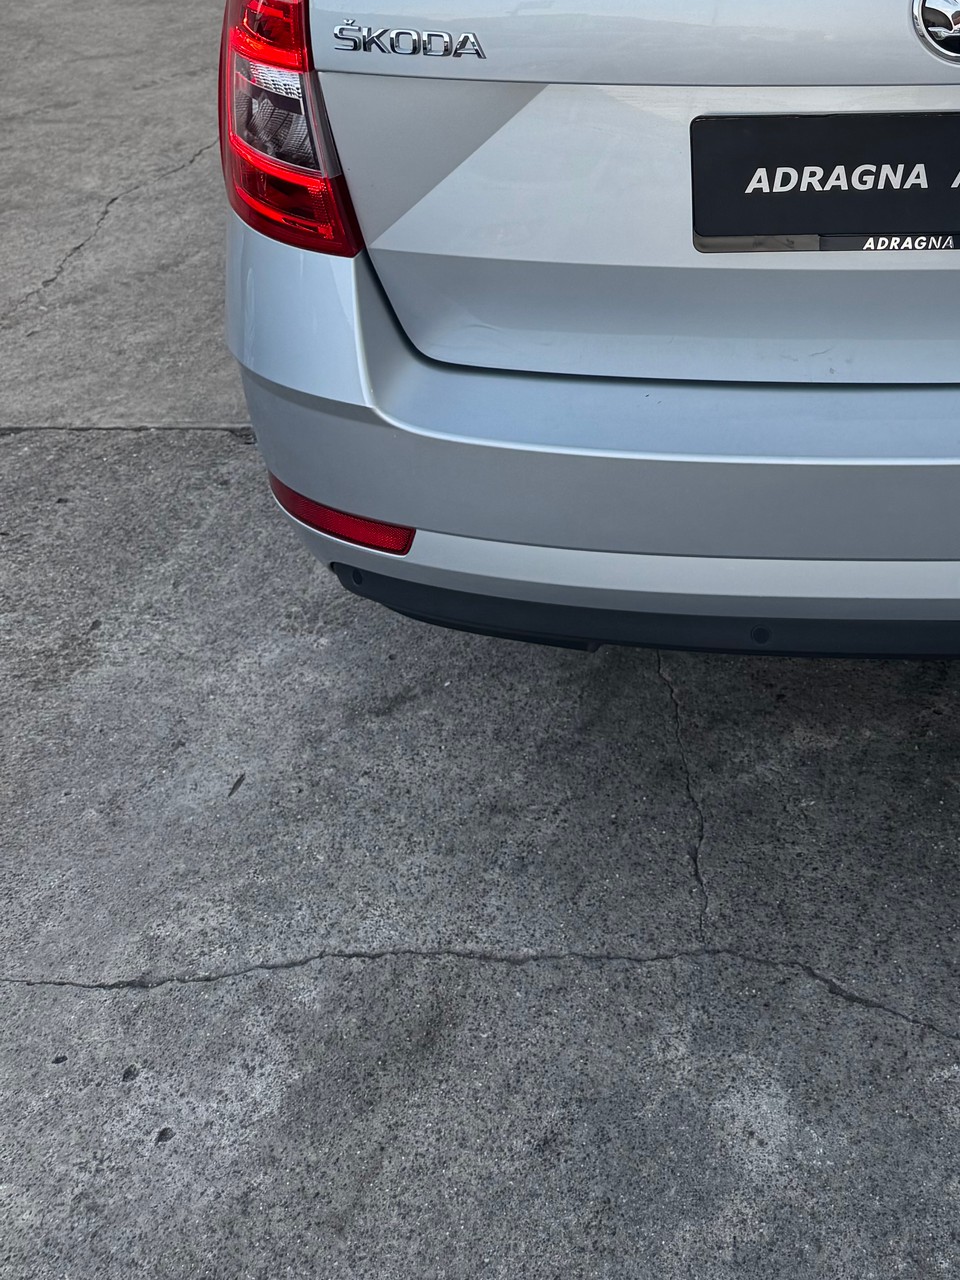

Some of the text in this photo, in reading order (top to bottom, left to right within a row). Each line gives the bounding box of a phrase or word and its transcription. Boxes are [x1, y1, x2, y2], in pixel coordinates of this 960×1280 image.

[333, 19, 487, 60] ŠKODA
[744, 163, 929, 194] ADRAGNA
[862, 235, 955, 251] ADRAGNA
